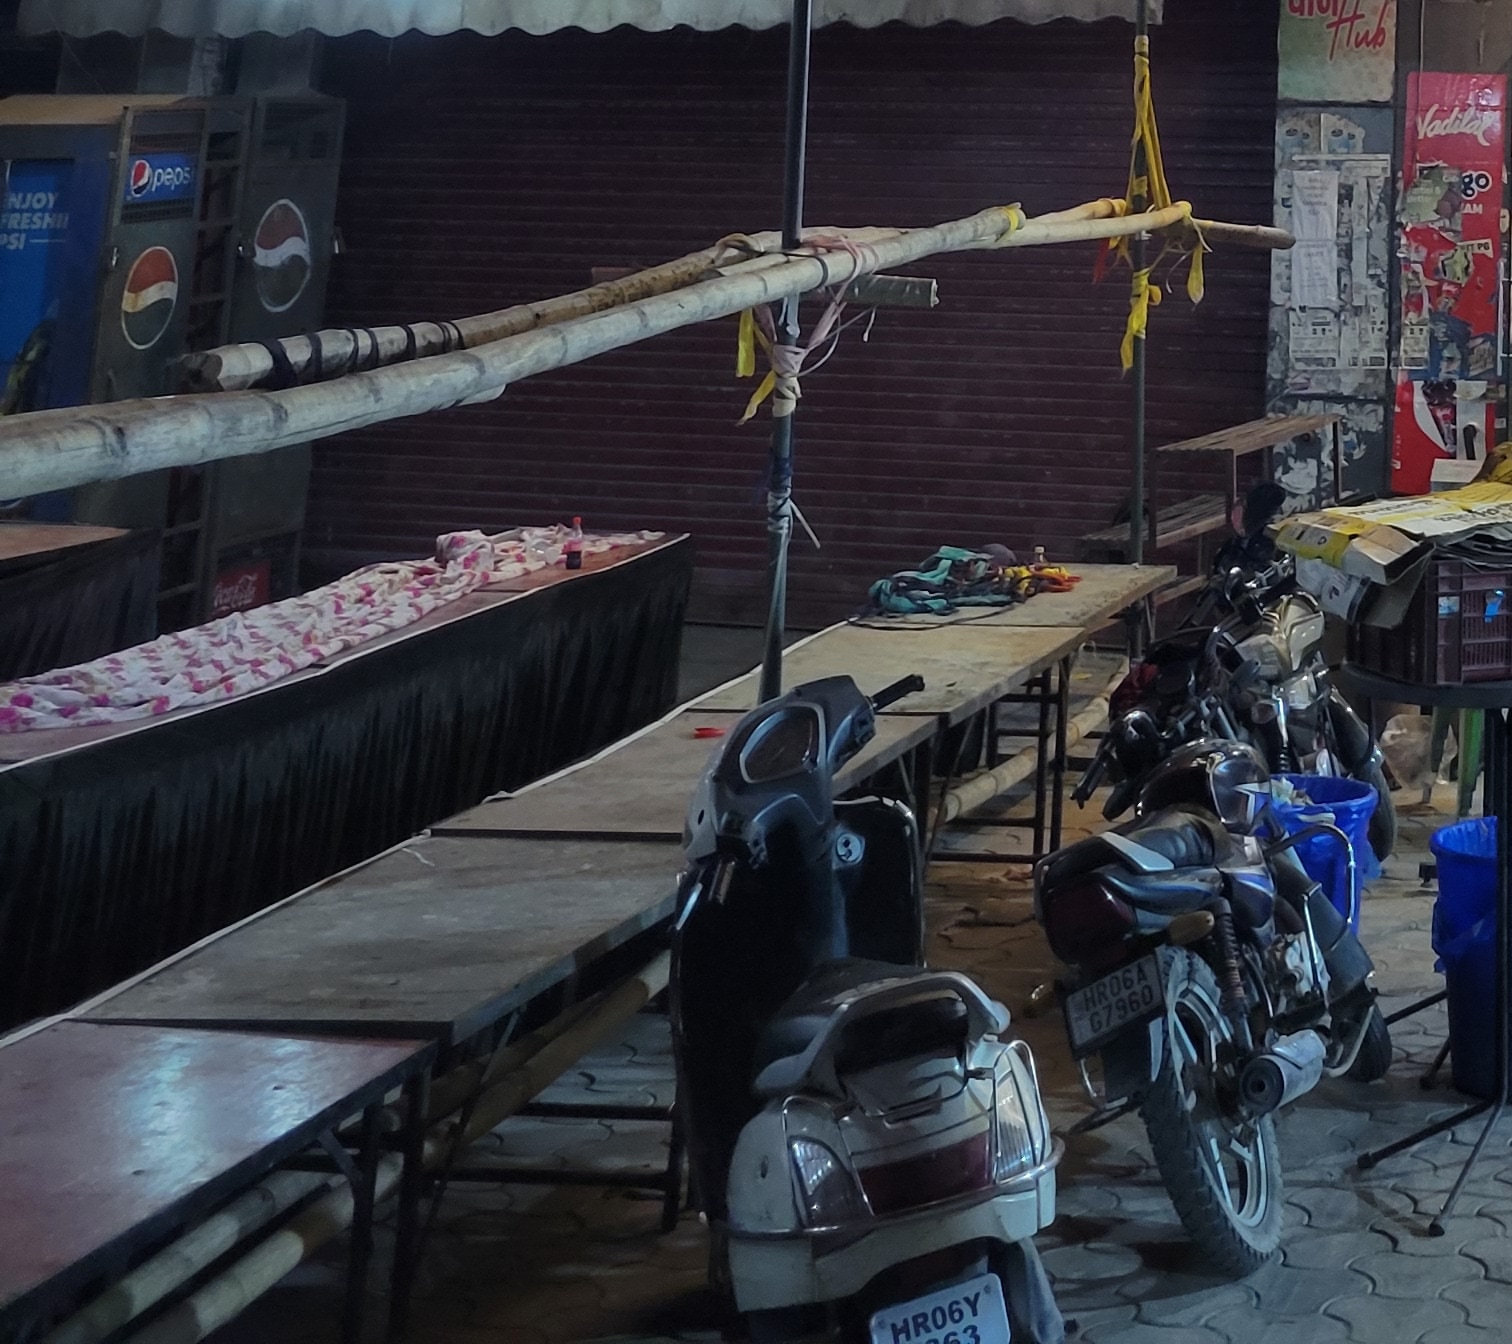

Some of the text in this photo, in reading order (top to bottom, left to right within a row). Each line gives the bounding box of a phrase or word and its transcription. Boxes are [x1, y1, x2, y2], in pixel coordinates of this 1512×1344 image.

[1083, 962, 1148, 1013] HR06A
[1089, 985, 1154, 1035] G7960
[890, 1291, 981, 1344] HR06Y
